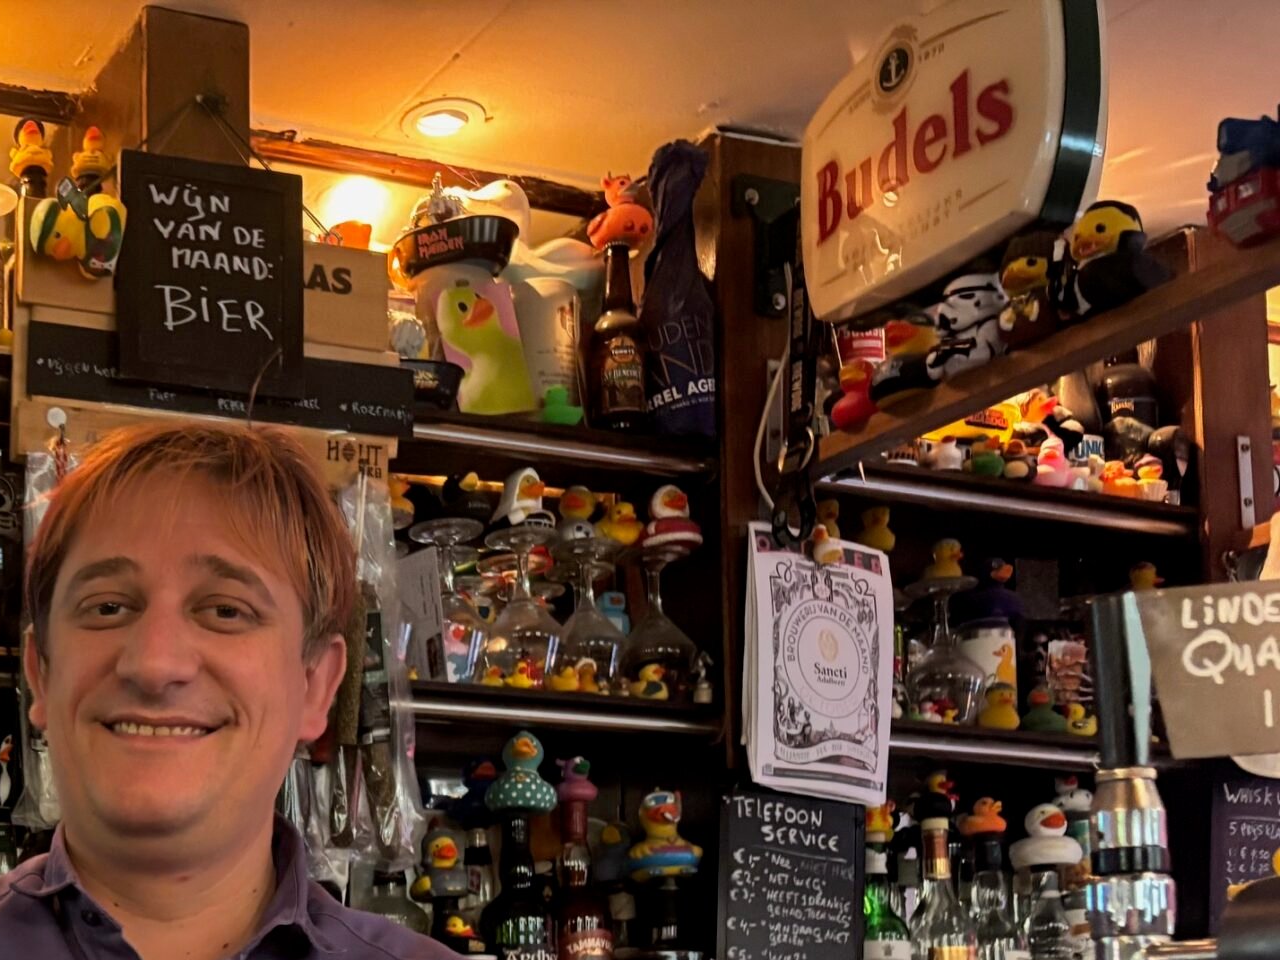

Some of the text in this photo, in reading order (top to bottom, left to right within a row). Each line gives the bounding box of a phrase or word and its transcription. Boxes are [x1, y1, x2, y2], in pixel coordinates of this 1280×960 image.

[816, 68, 1013, 248] Budels
[153, 218, 265, 249] VAN DE
[818, 603, 837, 617] VAN
[839, 613, 852, 627] DE
[814, 661, 847, 679] Sancti
[733, 796, 823, 827] TELEFOON
[761, 825, 839, 852] SERVICE
